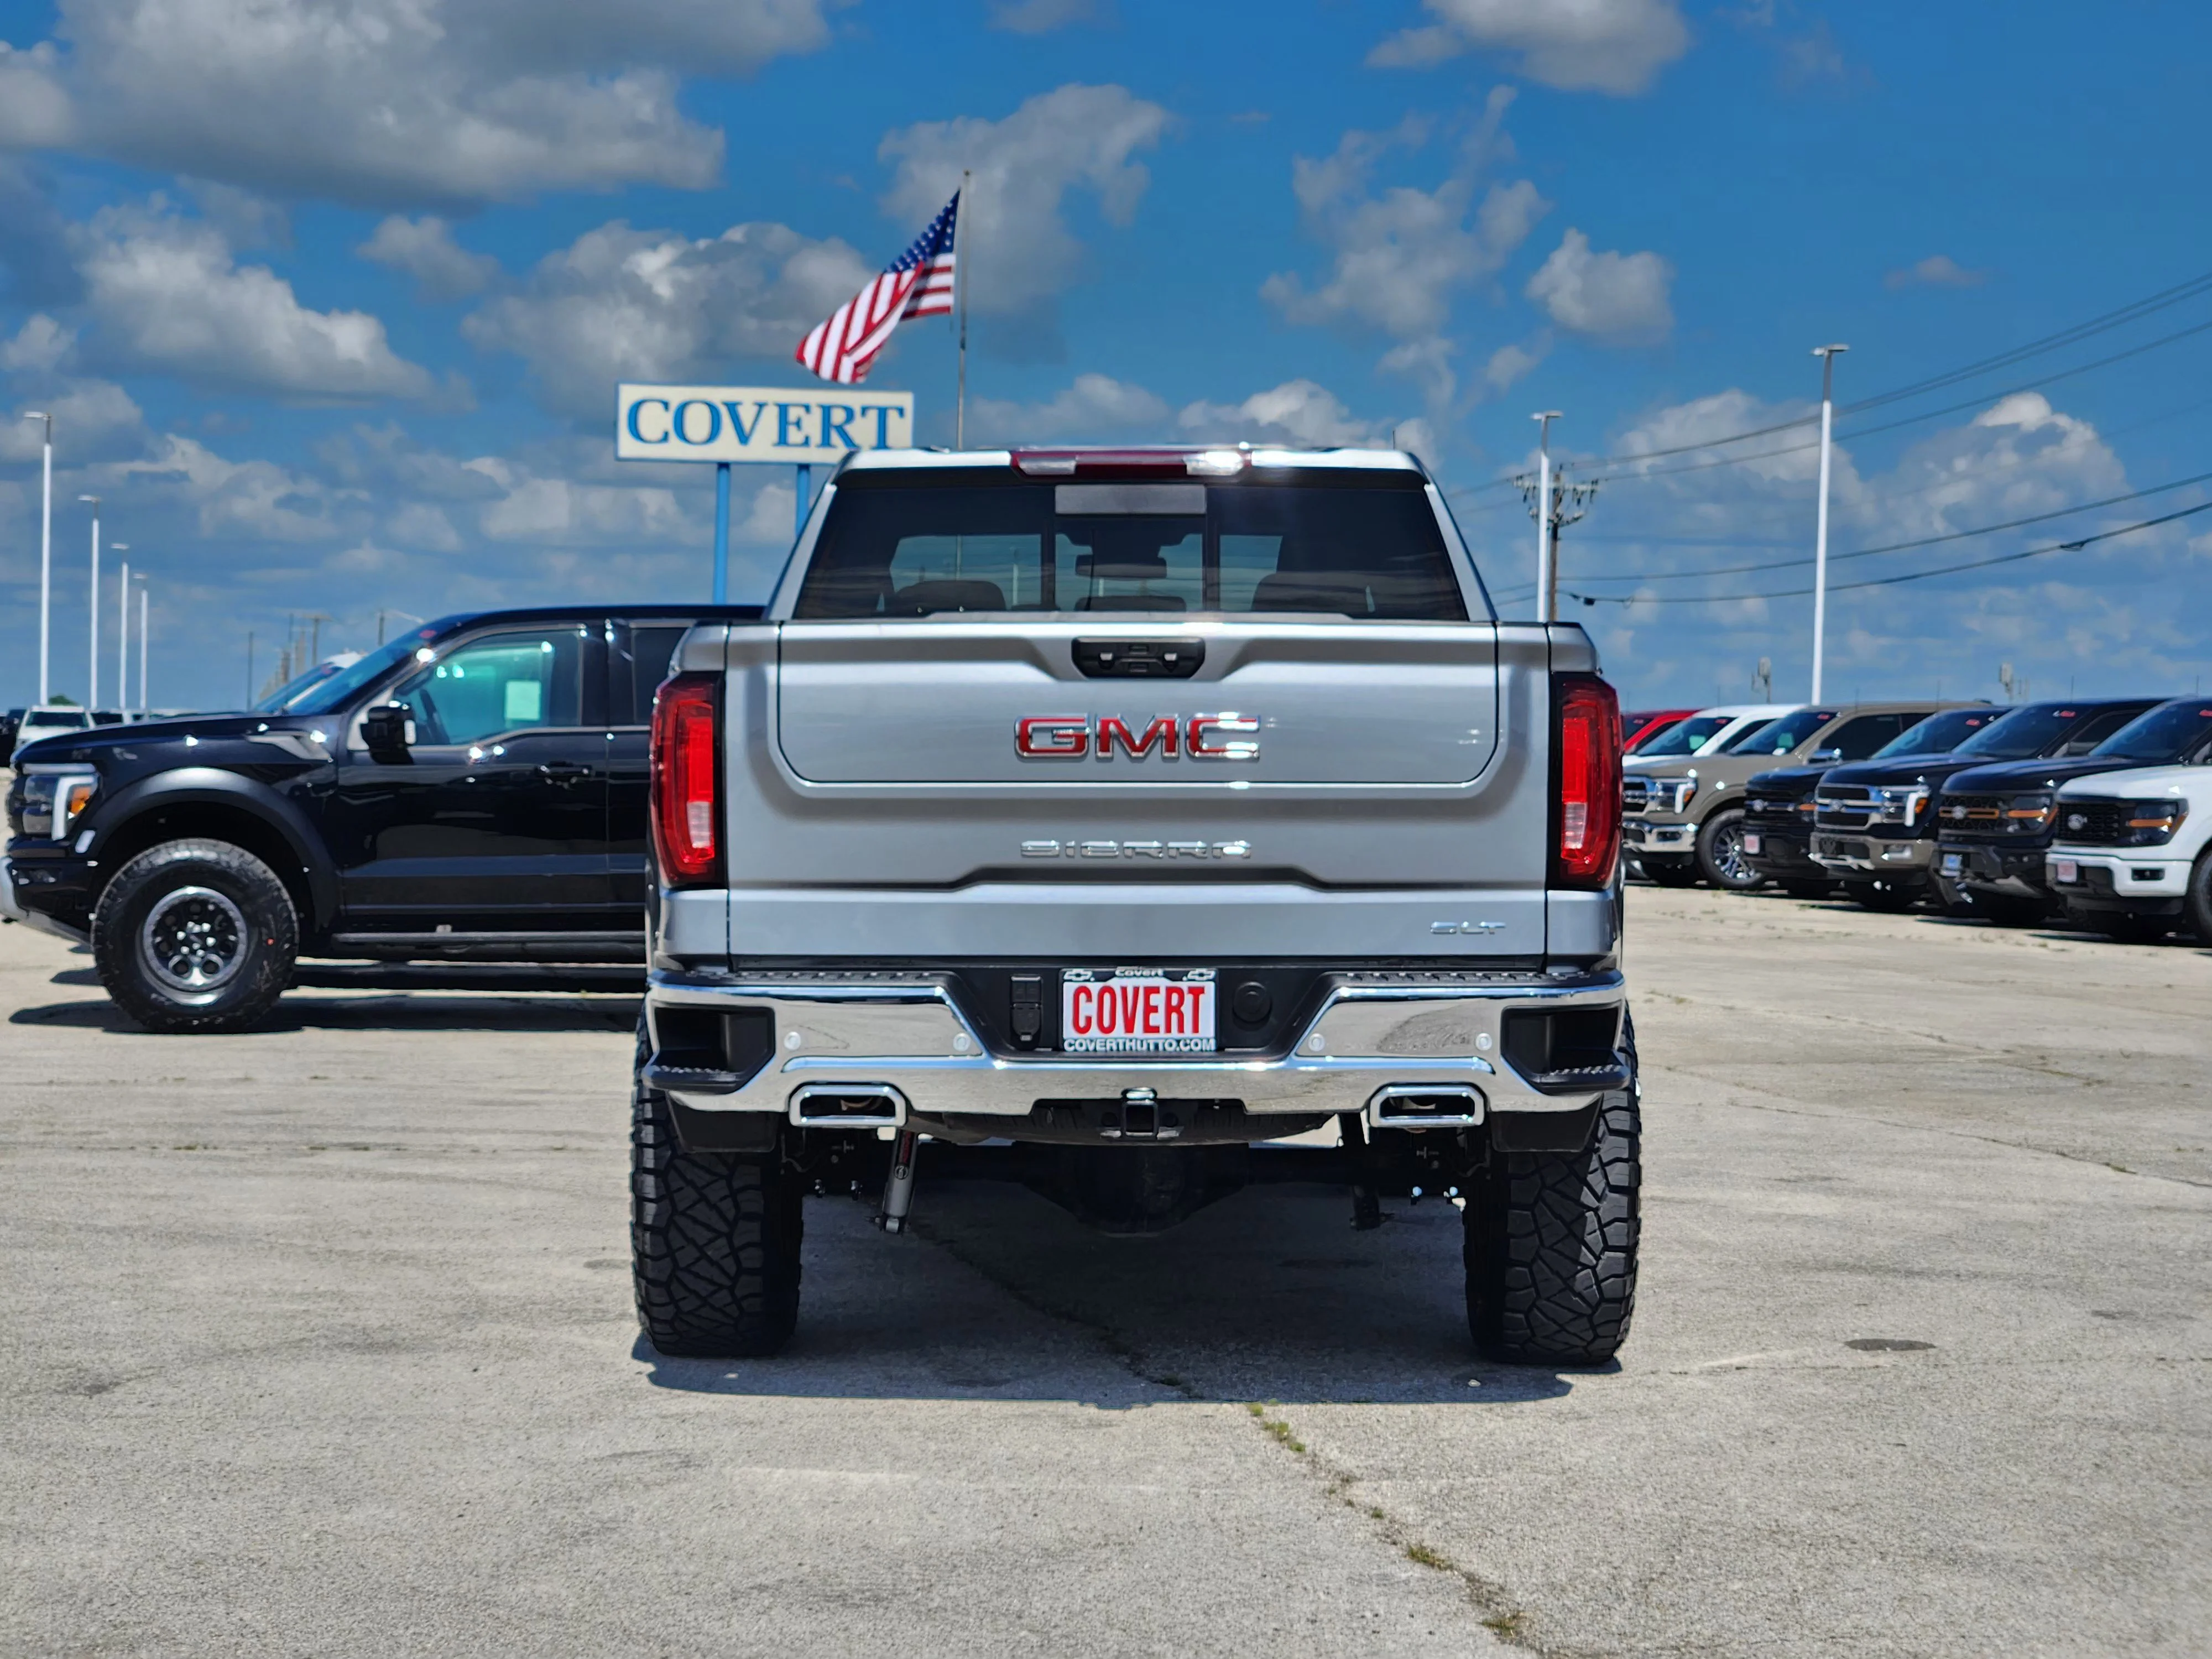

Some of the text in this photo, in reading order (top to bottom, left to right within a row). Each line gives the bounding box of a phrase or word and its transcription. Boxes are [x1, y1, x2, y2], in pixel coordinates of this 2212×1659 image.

[627, 399, 904, 449] COVERT
[1015, 712, 1260, 758] GMC
[1020, 841, 1251, 858] SIERRA
[1072, 985, 1205, 1034] COVERT
[1063, 1039, 1215, 1051] COVERTHUTTO.COM
